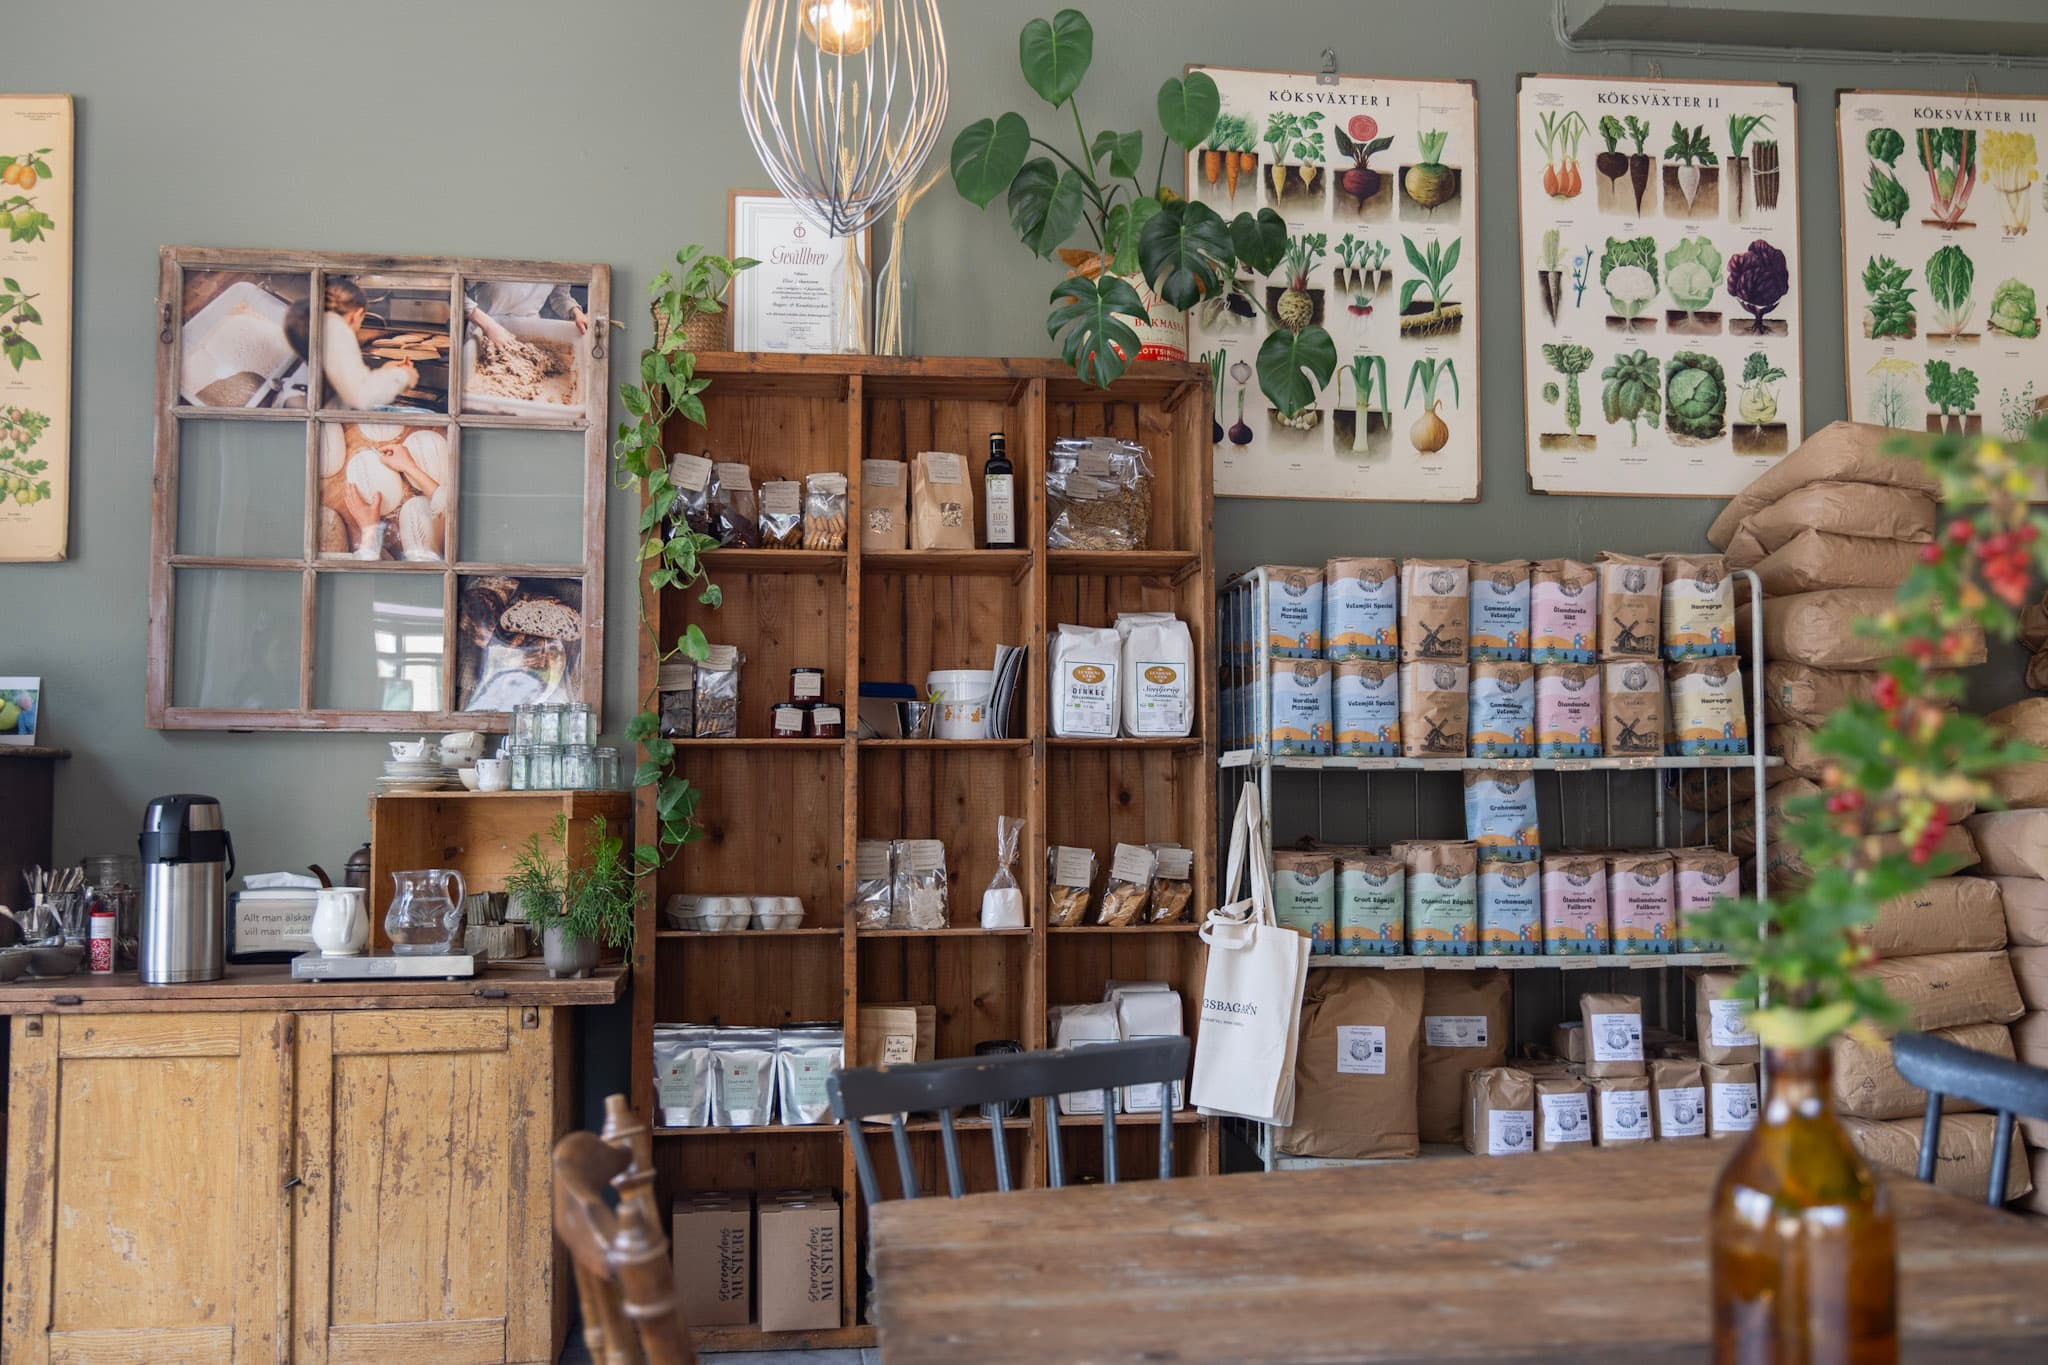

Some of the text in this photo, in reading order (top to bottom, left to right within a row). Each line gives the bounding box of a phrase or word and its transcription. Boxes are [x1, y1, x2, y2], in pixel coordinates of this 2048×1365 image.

[1269, 90, 1392, 107] KÖKSVÄXTER I
[1597, 91, 1720, 108] KÖKSVÄXTER II
[1913, 106, 2037, 123] KÖKSVÄXTER III
[1072, 687, 1105, 697] DINKEL
[243, 913, 260, 921] Allt
[244, 927, 258, 936] vill
[260, 928, 281, 936] man
[731, 1228, 744, 1301] MUSTERI
[820, 1226, 833, 1301] MUSTERI
